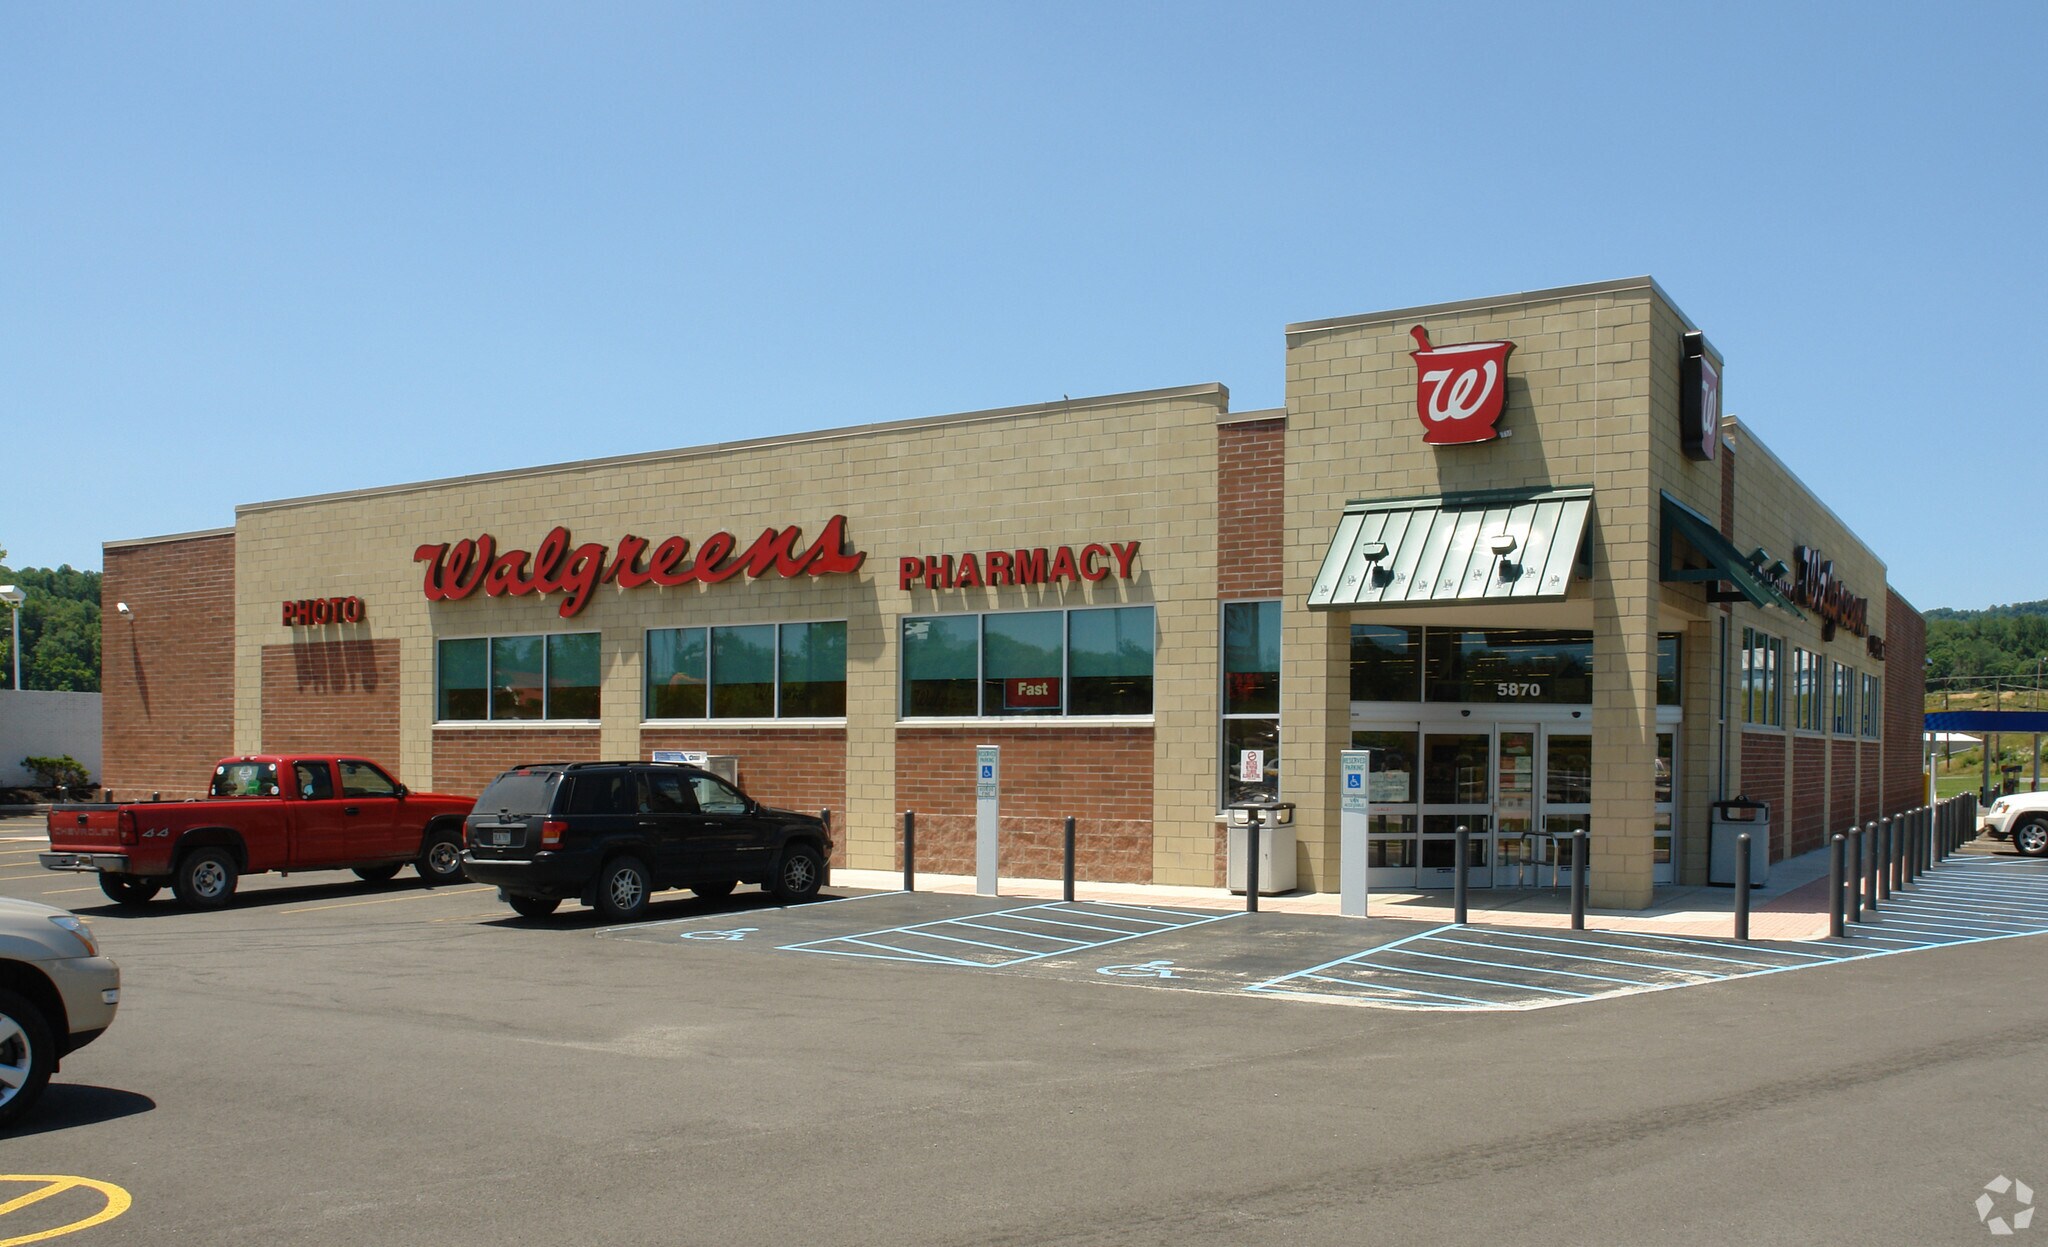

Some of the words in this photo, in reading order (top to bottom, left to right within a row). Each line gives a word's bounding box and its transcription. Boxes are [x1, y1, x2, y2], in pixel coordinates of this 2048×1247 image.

[1421, 360, 1498, 423] W
[1701, 379, 1717, 436] W
[414, 514, 867, 619] Walgreens
[899, 540, 1142, 591] PHARMACY
[282, 595, 366, 627] PHOTO
[1017, 682, 1048, 697] Fast
[1497, 682, 1541, 698] 5870
[54, 827, 115, 837] CHEVROLET
